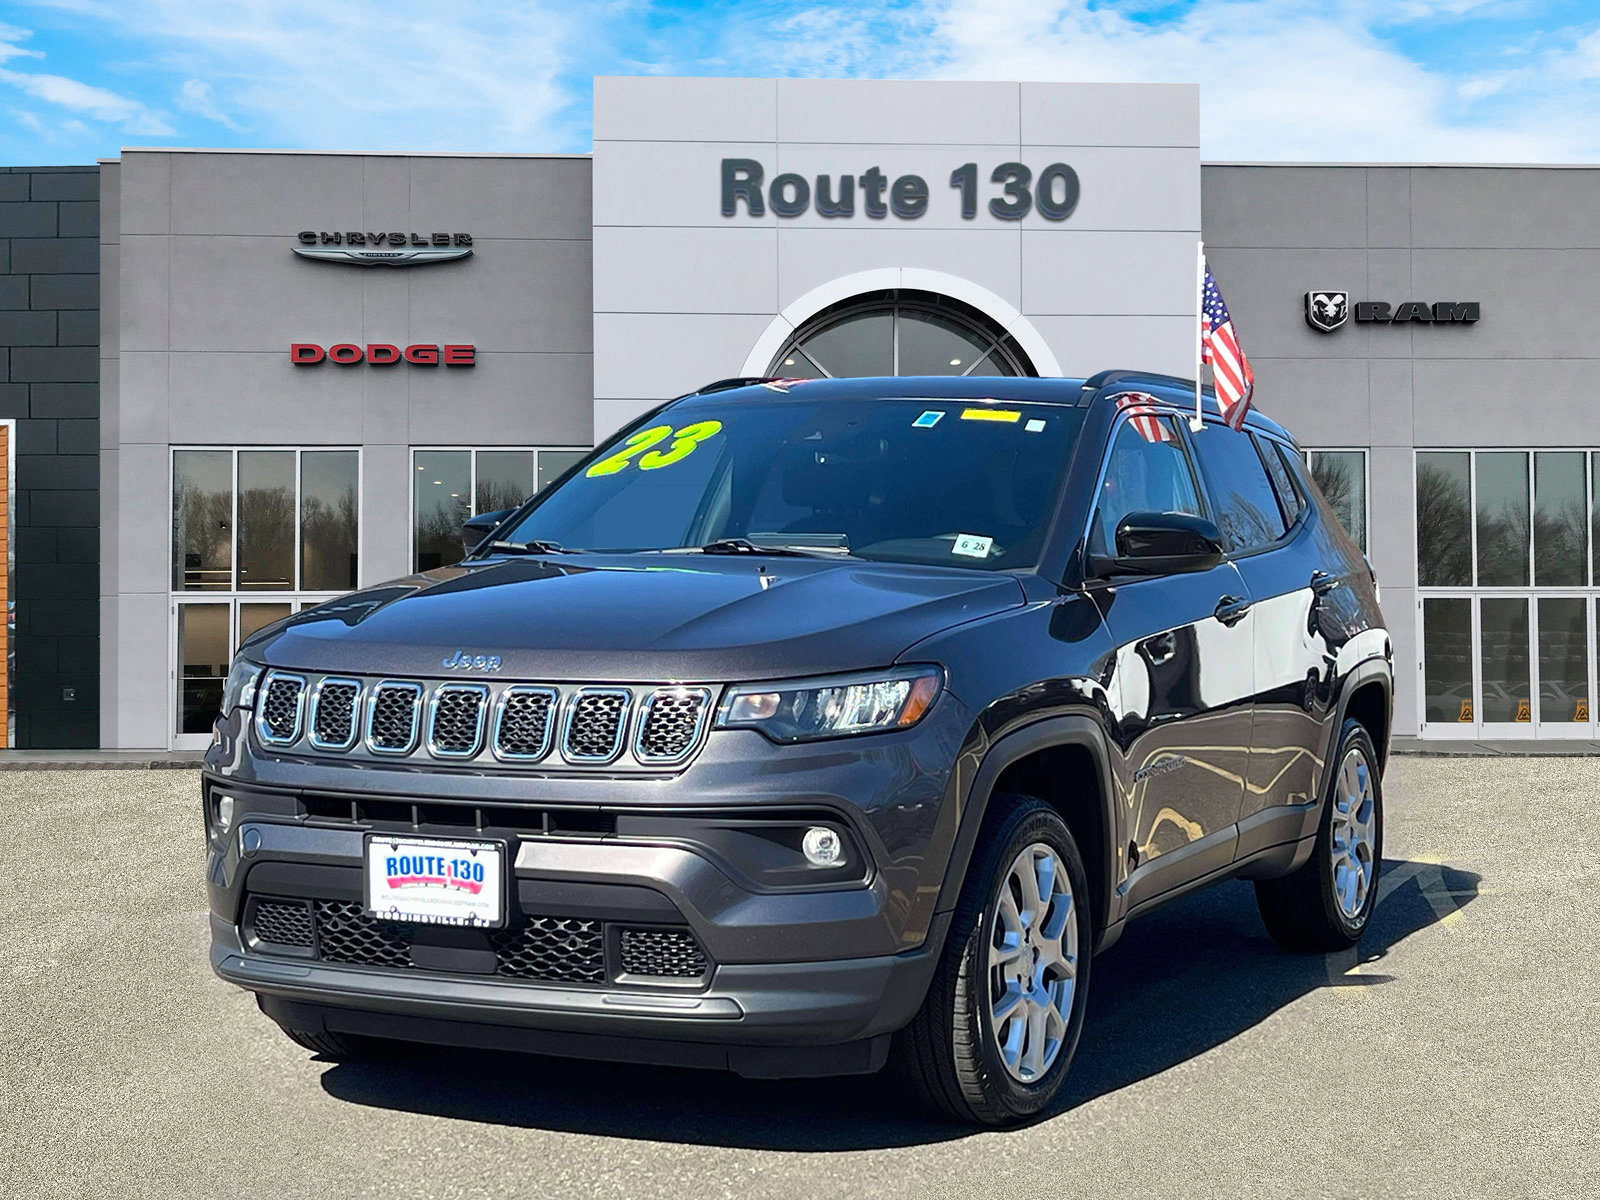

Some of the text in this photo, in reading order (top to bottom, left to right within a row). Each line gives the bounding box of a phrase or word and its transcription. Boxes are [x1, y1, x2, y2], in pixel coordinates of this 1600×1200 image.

[721, 158, 1080, 220] Route 130
[298, 231, 473, 245] CHRYSLER
[1354, 302, 1480, 323] RAM
[291, 343, 475, 365] DODGE
[586, 420, 722, 478] 23
[442, 650, 503, 672] Jeep
[386, 855, 485, 883] ROUTE 130
